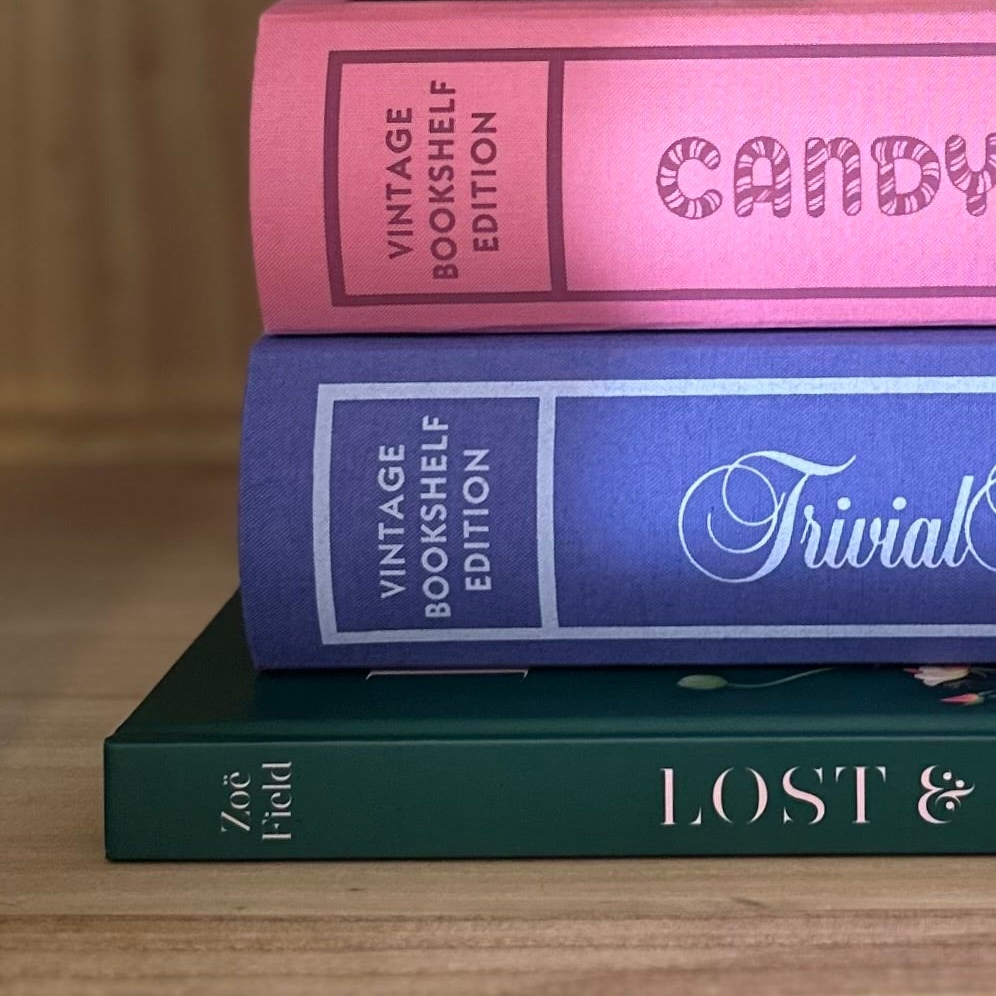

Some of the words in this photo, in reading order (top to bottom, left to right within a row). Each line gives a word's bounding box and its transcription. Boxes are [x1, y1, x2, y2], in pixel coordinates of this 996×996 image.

[385, 106, 414, 260] VINTAGE
[427, 78, 459, 281] BOOKSHELF
[471, 111, 499, 253] EDITION
[378, 443, 406, 599] VINTAGE
[422, 415, 452, 619] BOOKSHELF
[464, 447, 491, 592] EDITION
[679, 450, 976, 583] Trivial
[220, 770, 252, 834] Zoë
[260, 760, 293, 841] Field
[660, 765, 887, 826] LOST
[918, 764, 976, 825] &
